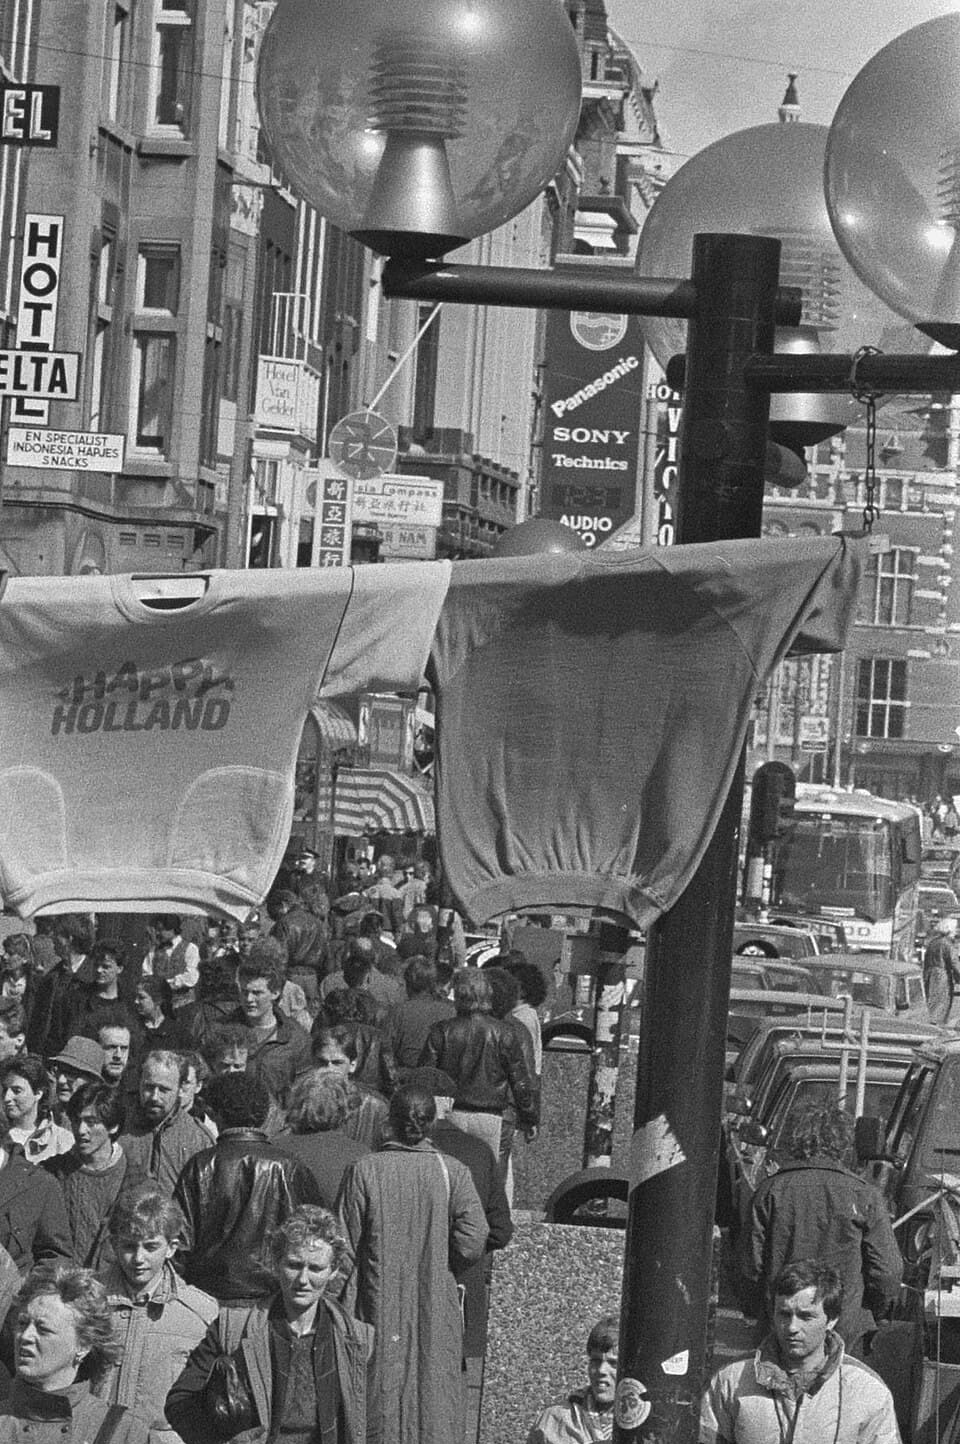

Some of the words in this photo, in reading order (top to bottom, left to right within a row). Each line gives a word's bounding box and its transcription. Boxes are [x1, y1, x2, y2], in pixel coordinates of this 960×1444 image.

[550, 355, 640, 419] Panasonic
[25, 431, 42, 442] EN
[46, 433, 108, 447] SPECIALIST
[552, 427, 631, 444] SONY
[13, 442, 74, 455] INDONESIA
[42, 456, 89, 468] SNACKS
[551, 454, 629, 470] Technics
[559, 514, 613, 532] AUDIO
[50, 698, 231, 736] HOLLAND
